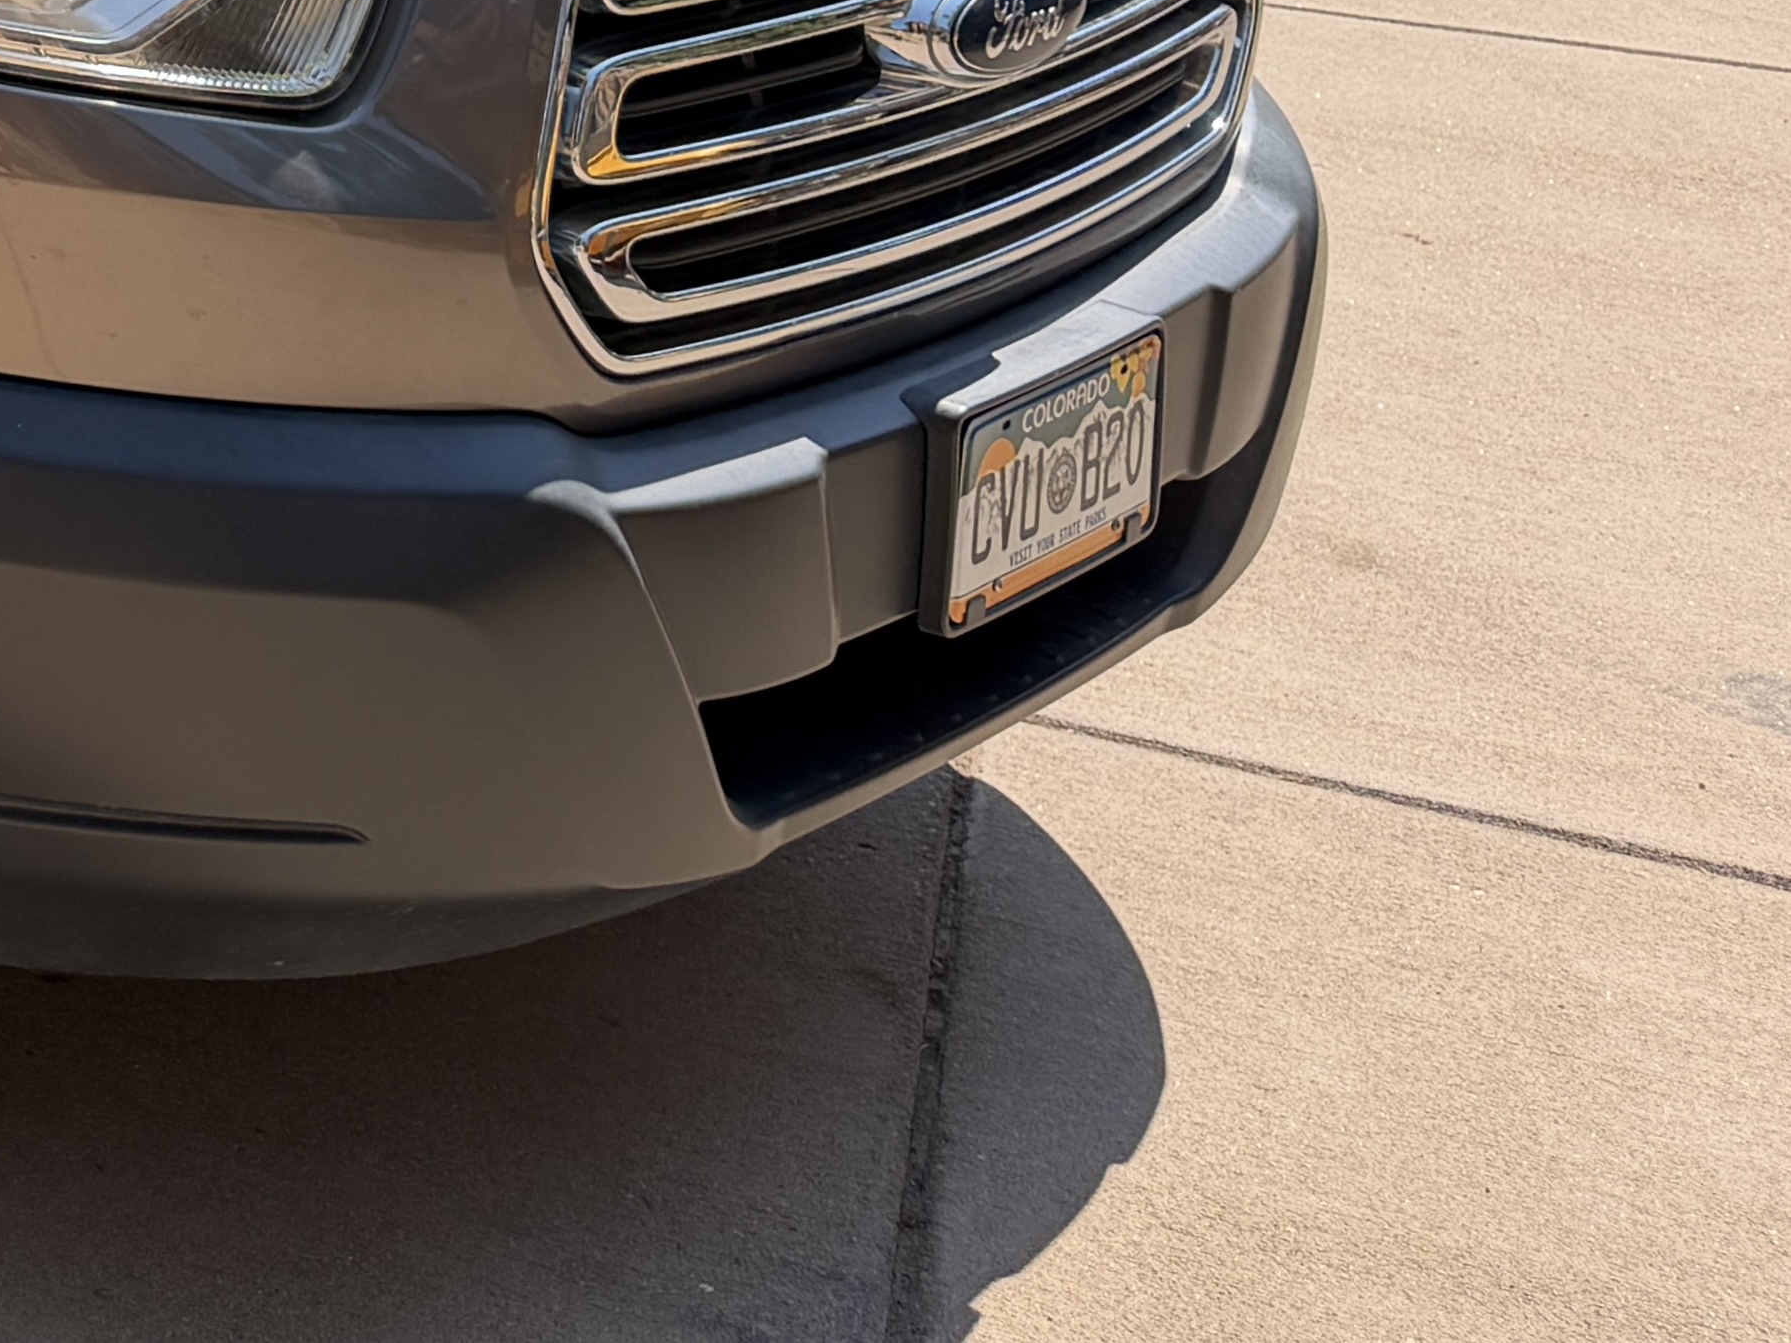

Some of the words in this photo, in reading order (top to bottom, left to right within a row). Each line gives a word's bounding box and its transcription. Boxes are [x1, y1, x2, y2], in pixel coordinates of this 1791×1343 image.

[1022, 373, 1110, 433] COLORADO
[971, 447, 1045, 565] CVU
[1080, 398, 1145, 512] B20
[1009, 544, 1032, 567] VISIT
[1037, 533, 1055, 554] YOUR
[1059, 519, 1081, 543] STATE
